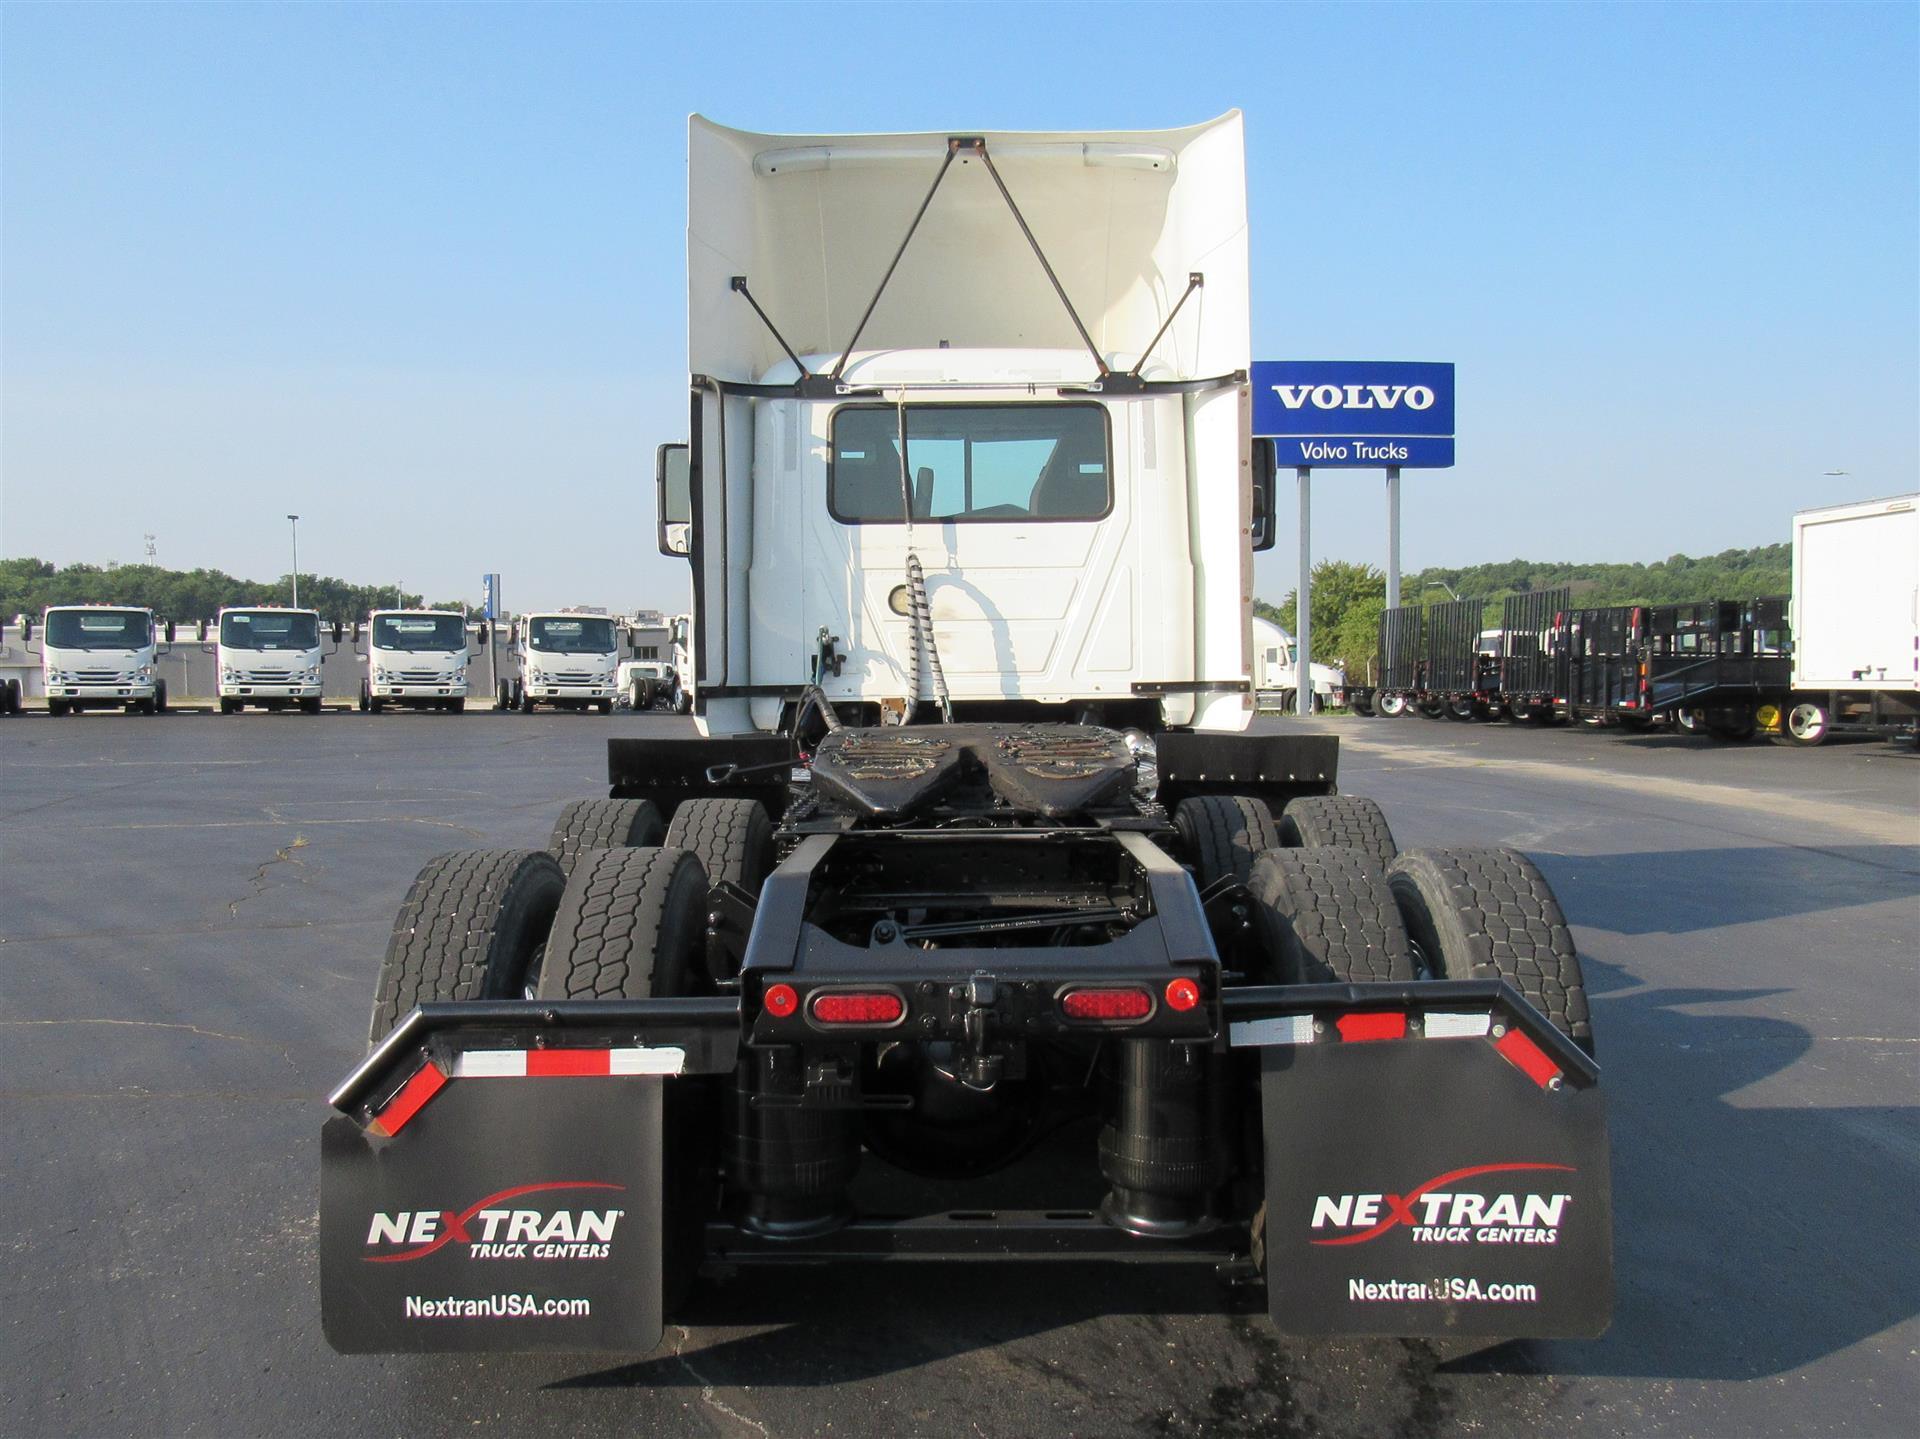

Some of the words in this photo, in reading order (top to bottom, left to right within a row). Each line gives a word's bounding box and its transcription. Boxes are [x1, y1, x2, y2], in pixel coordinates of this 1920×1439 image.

[1272, 385, 1434, 410] VOLVO
[1300, 442, 1347, 460] Volvo
[1352, 442, 1408, 460] Trucks
[1412, 1227, 1469, 1243] TRUCK
[1476, 1227, 1557, 1243] CENTERS
[470, 1243, 527, 1259] TRUCK
[533, 1243, 610, 1259] CENTERS
[405, 1294, 590, 1319] NextranUSA.com
